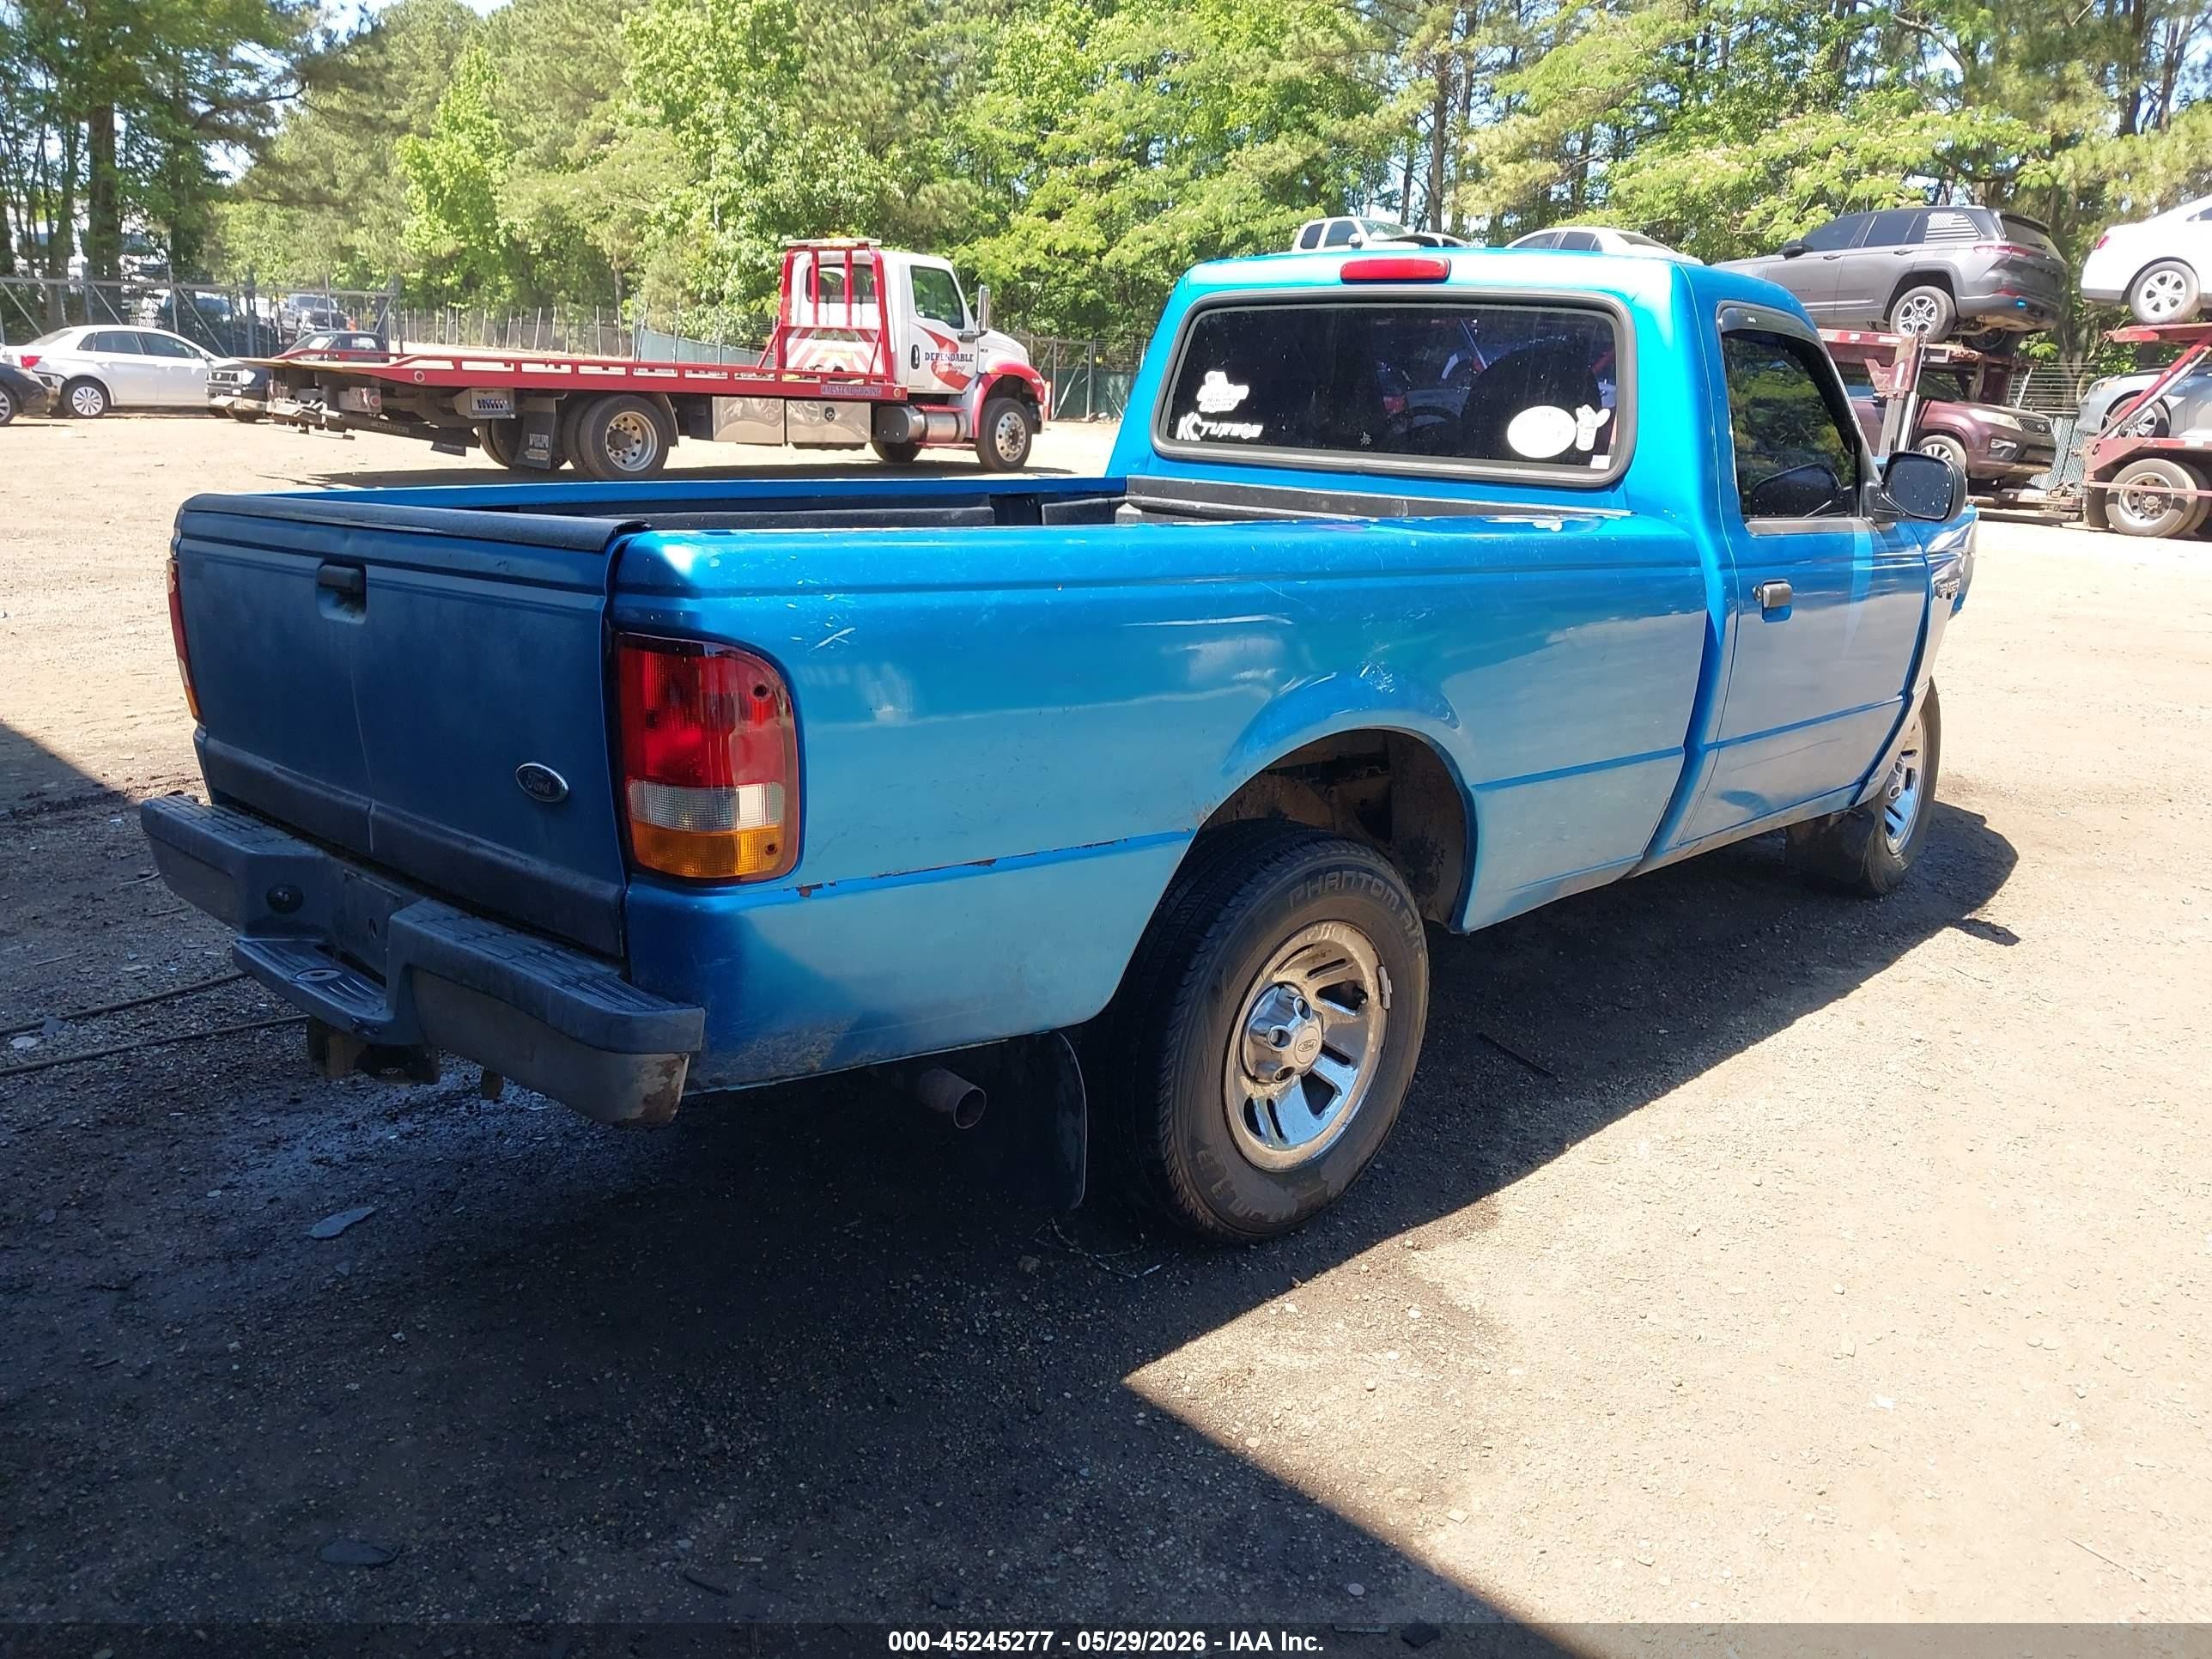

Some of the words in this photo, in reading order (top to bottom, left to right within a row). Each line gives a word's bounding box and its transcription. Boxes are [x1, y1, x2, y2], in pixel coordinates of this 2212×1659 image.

[924, 351, 974, 362] DEPENDABLE
[1176, 412, 1201, 441] KC
[1288, 870, 1401, 911] PHANTOM
